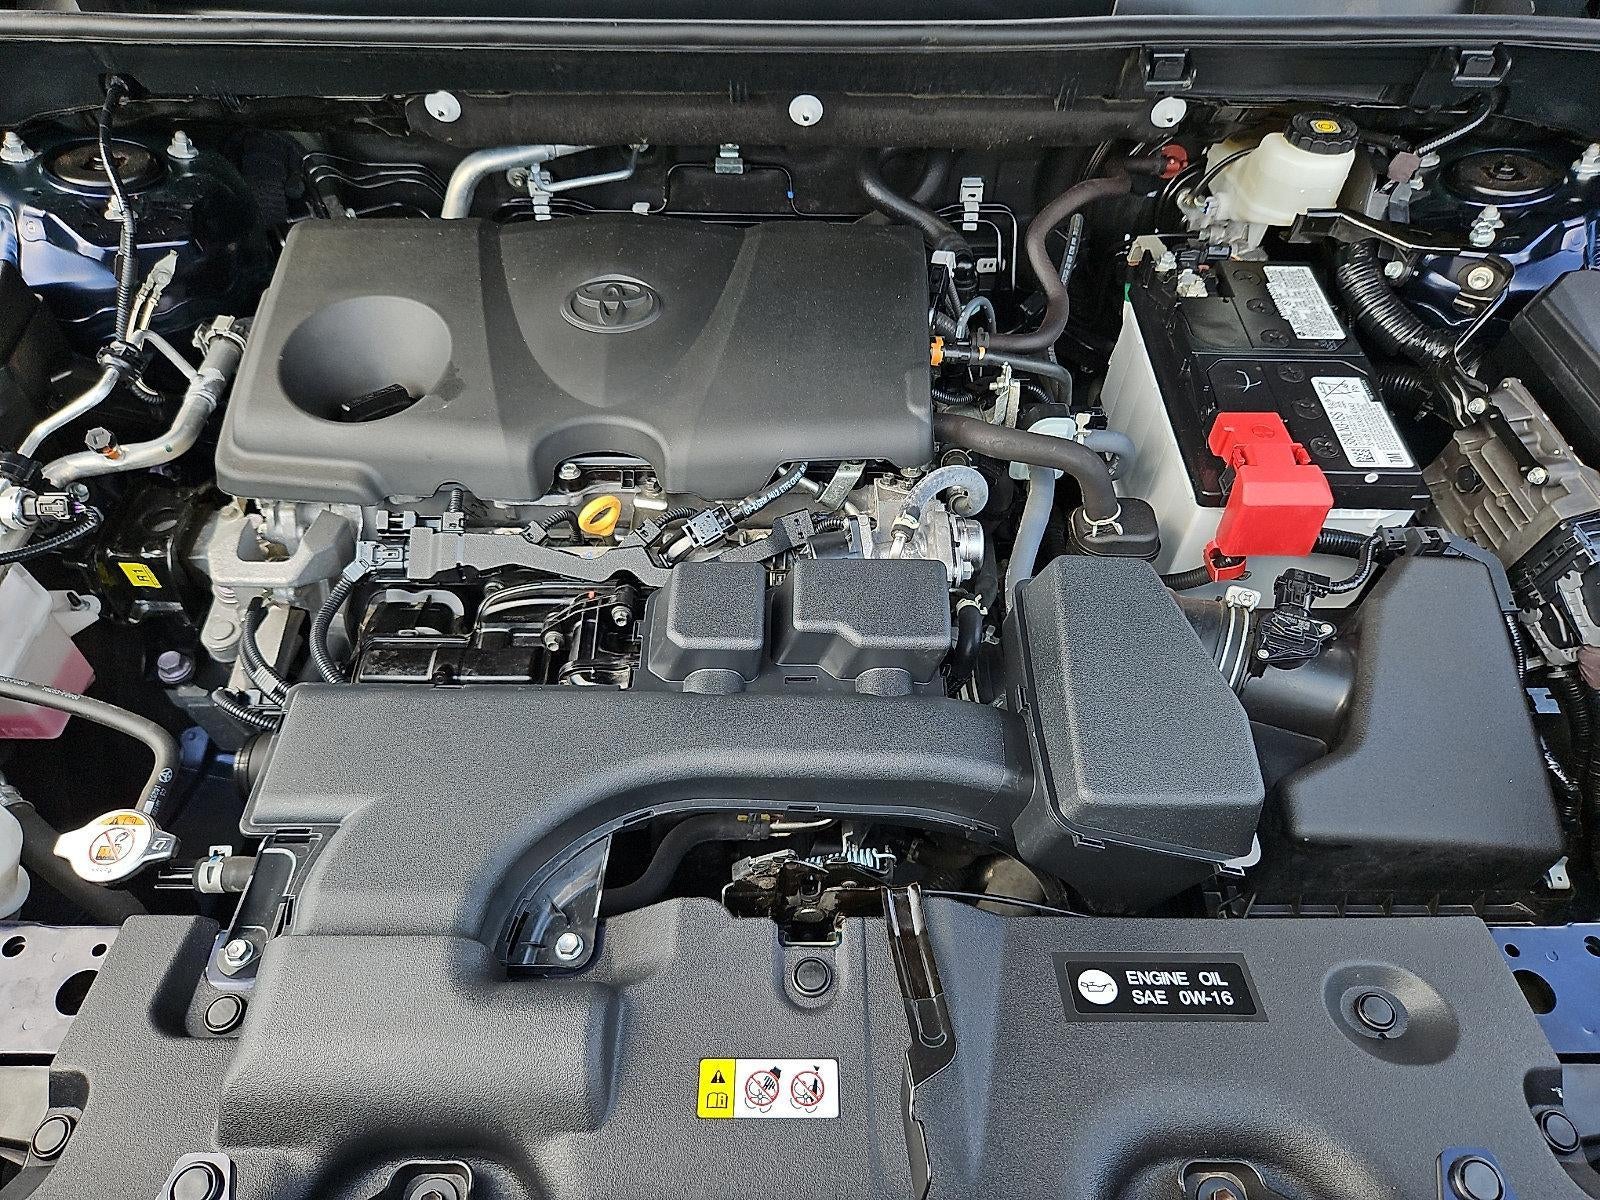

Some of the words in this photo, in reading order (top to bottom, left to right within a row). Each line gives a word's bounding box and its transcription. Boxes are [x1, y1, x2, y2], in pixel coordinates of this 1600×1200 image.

[1125, 970, 1190, 986] ENGINE
[1198, 971, 1229, 986] OIL
[1132, 989, 1169, 1005] SAE
[1179, 990, 1235, 1006] 0W-16
